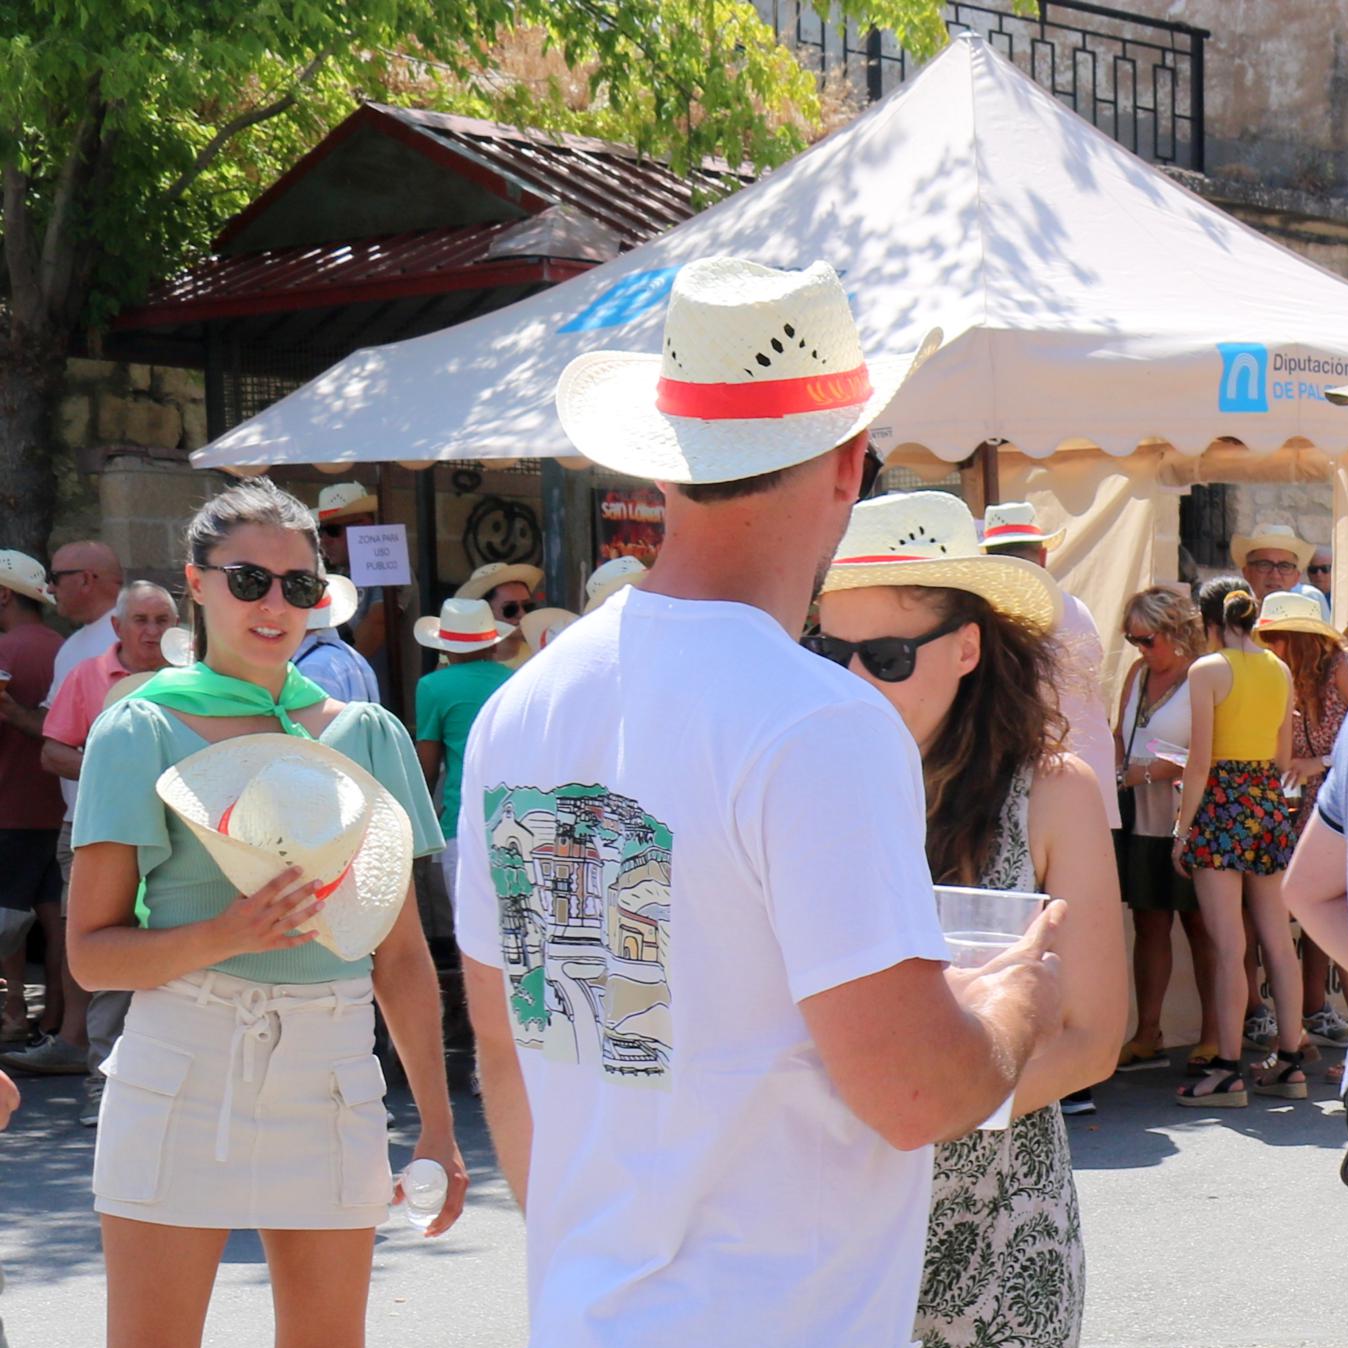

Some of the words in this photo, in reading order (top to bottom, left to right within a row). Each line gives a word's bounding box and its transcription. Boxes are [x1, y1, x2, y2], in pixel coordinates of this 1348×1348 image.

[1273, 381, 1295, 400] DE
[358, 535, 381, 544] ZONA
[374, 547, 391, 557] USO
